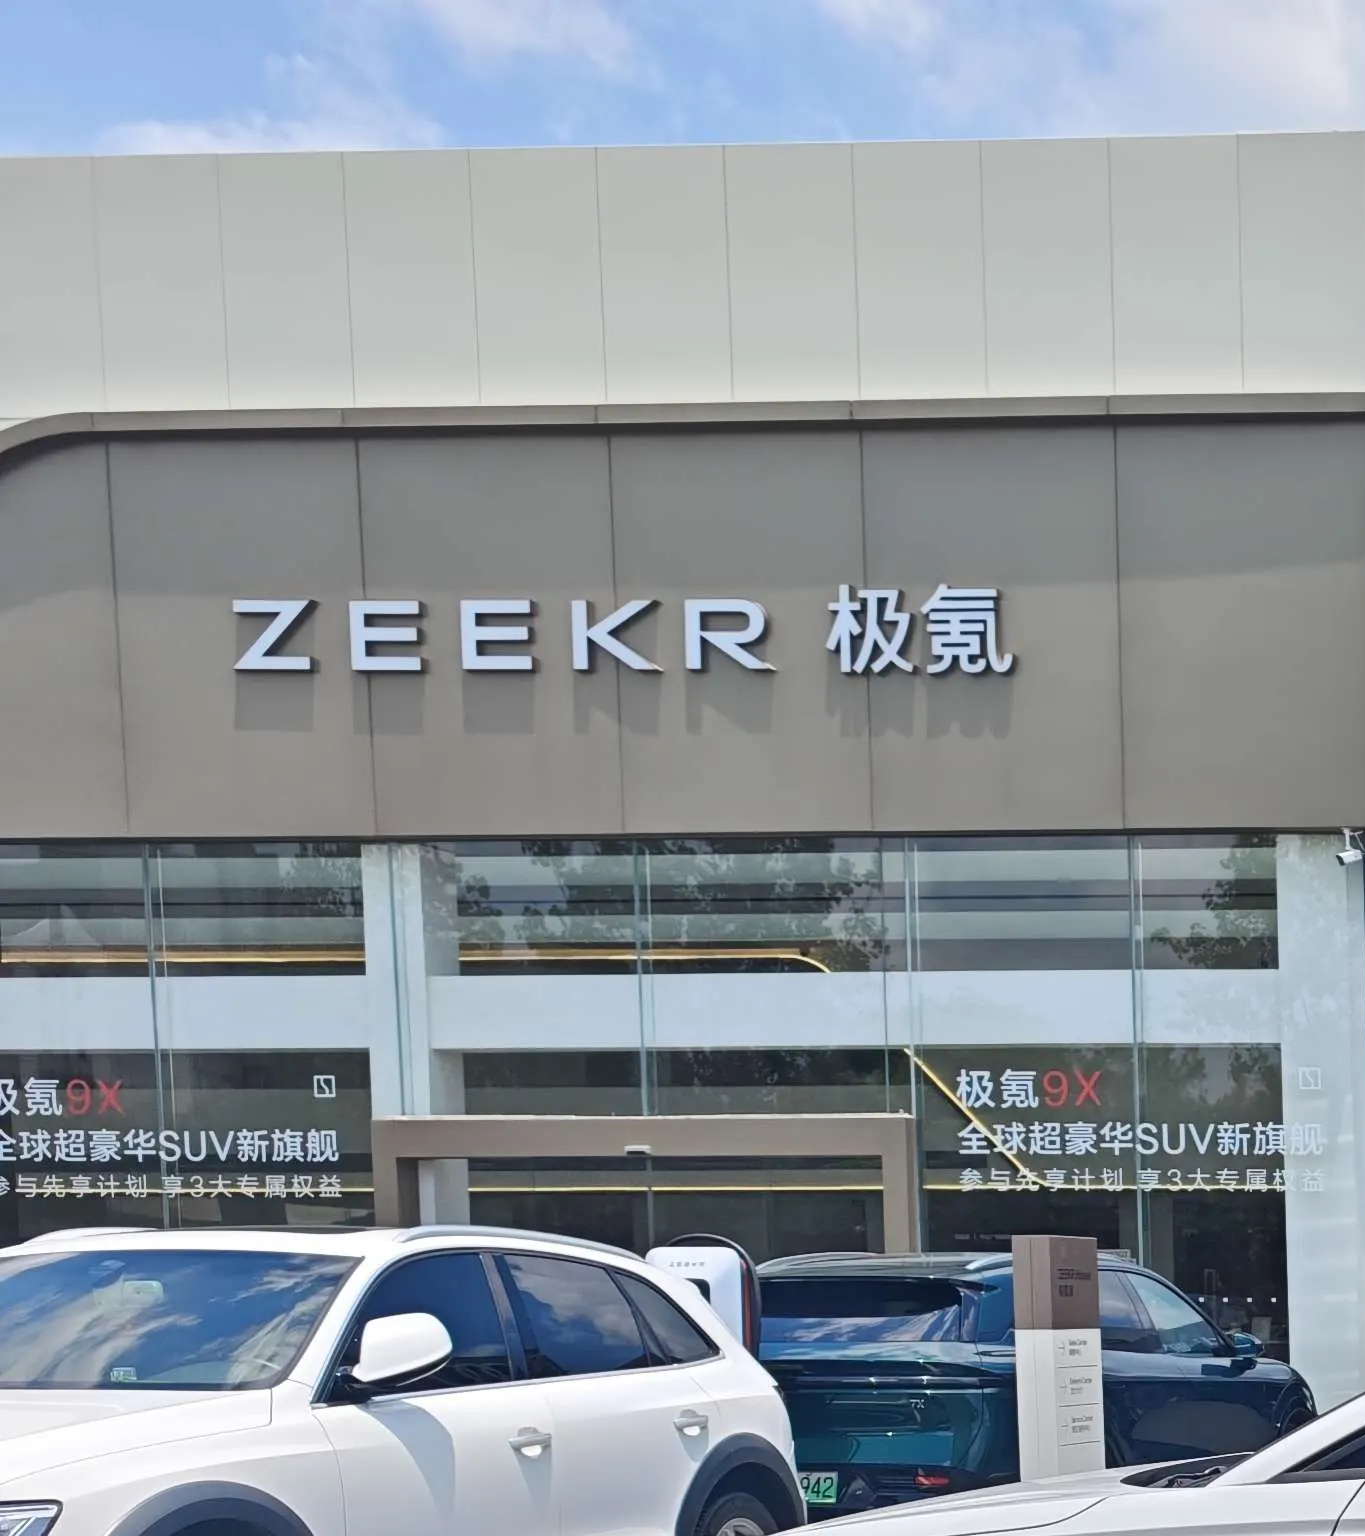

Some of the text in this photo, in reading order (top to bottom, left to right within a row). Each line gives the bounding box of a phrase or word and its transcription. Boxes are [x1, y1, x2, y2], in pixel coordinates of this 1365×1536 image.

[232, 582, 1015, 677] ZEEKR 极氪
[956, 1068, 1101, 1110] 极氪9X
[956, 1121, 1325, 1157] 全球超豪华SUV新旗舰
